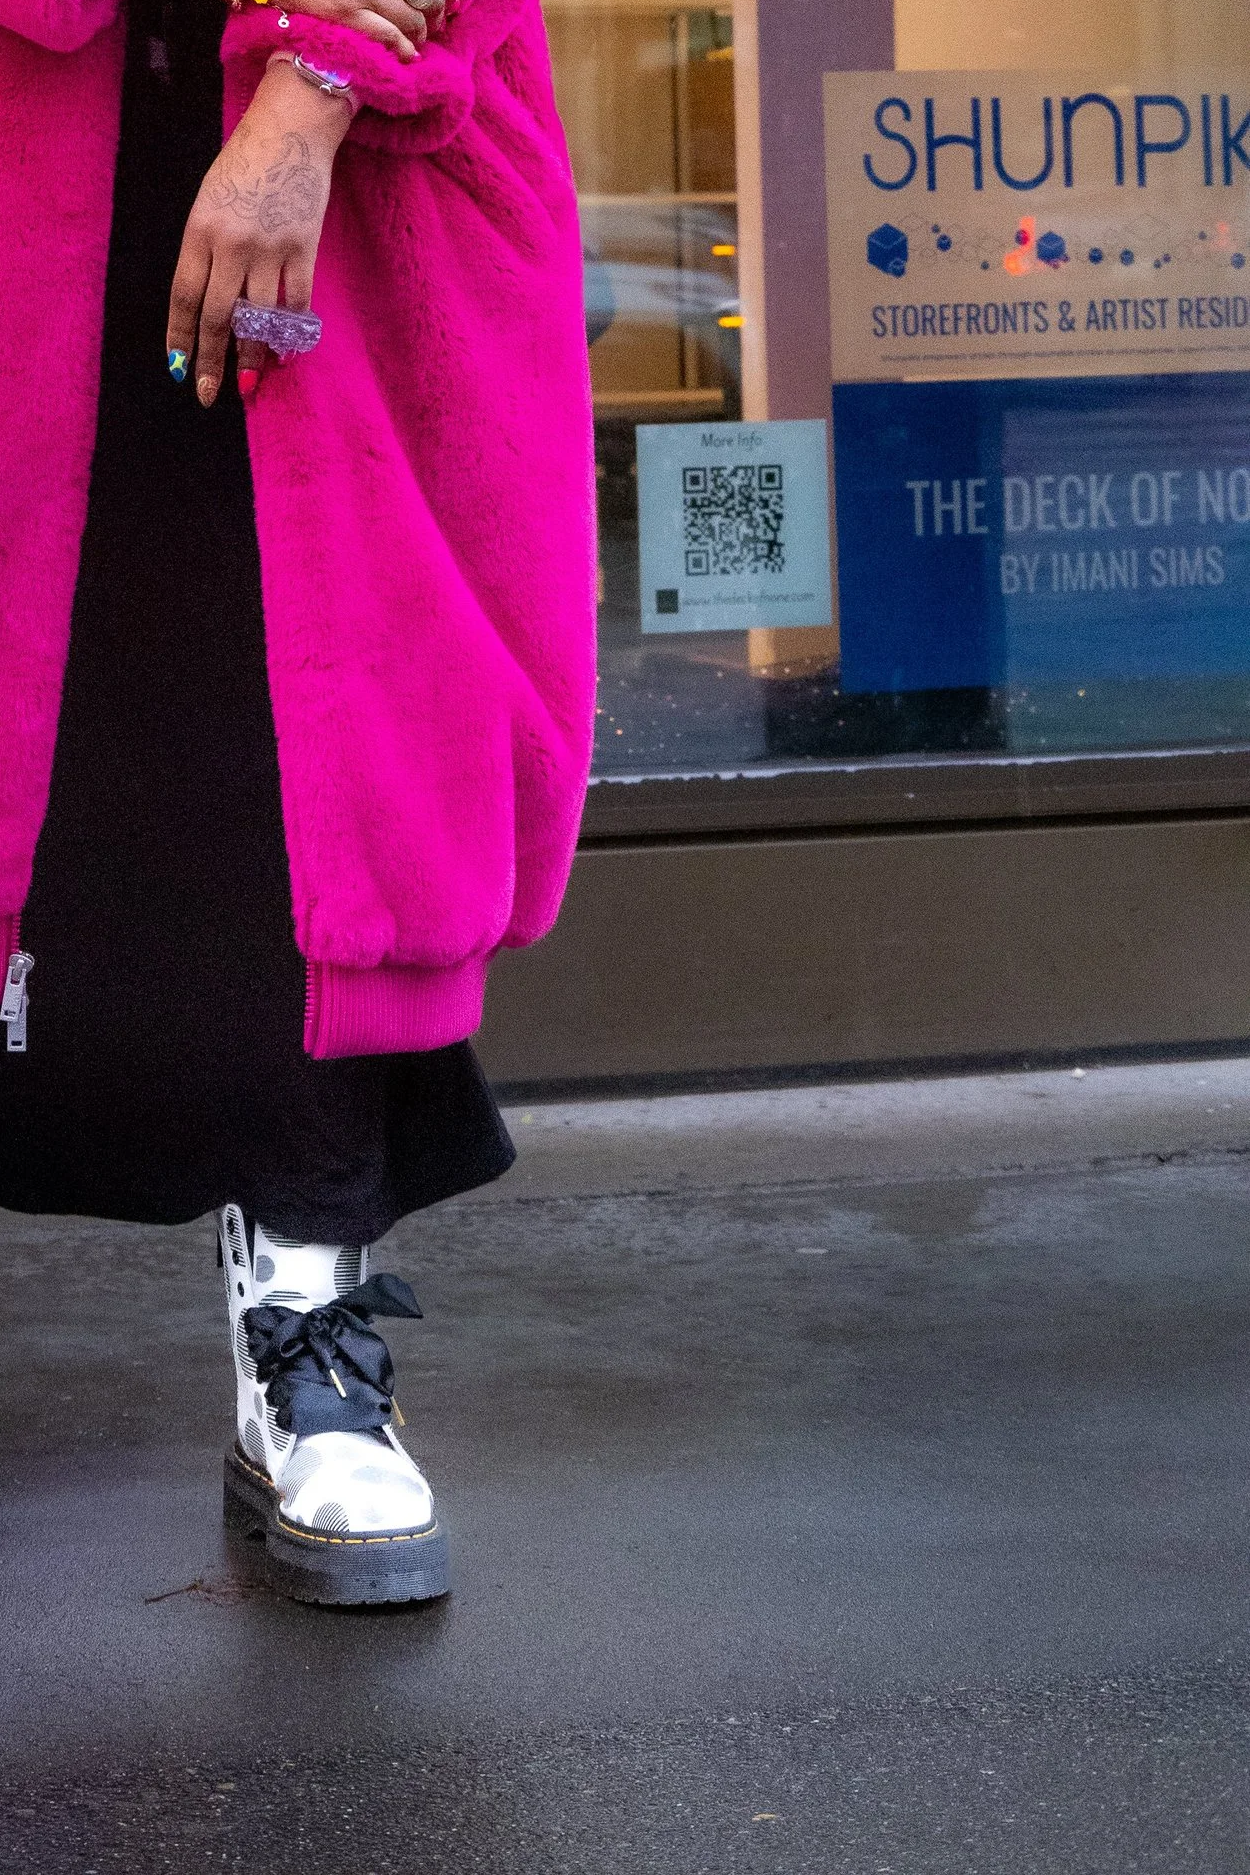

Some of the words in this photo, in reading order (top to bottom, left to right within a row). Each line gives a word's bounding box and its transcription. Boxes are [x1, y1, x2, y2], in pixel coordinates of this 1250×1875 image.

[871, 300, 1049, 339] STOREFRONTS
[1057, 300, 1076, 333] &
[1085, 298, 1169, 333] ARTIST
[701, 433, 734, 448] More
[738, 432, 763, 447] Info
[905, 478, 989, 537] THE
[1003, 473, 1118, 533] DECK
[1129, 470, 1181, 527] OF
[1001, 552, 1041, 595] BY
[1051, 549, 1139, 593] IMANI
[1150, 546, 1225, 589] SIMS
